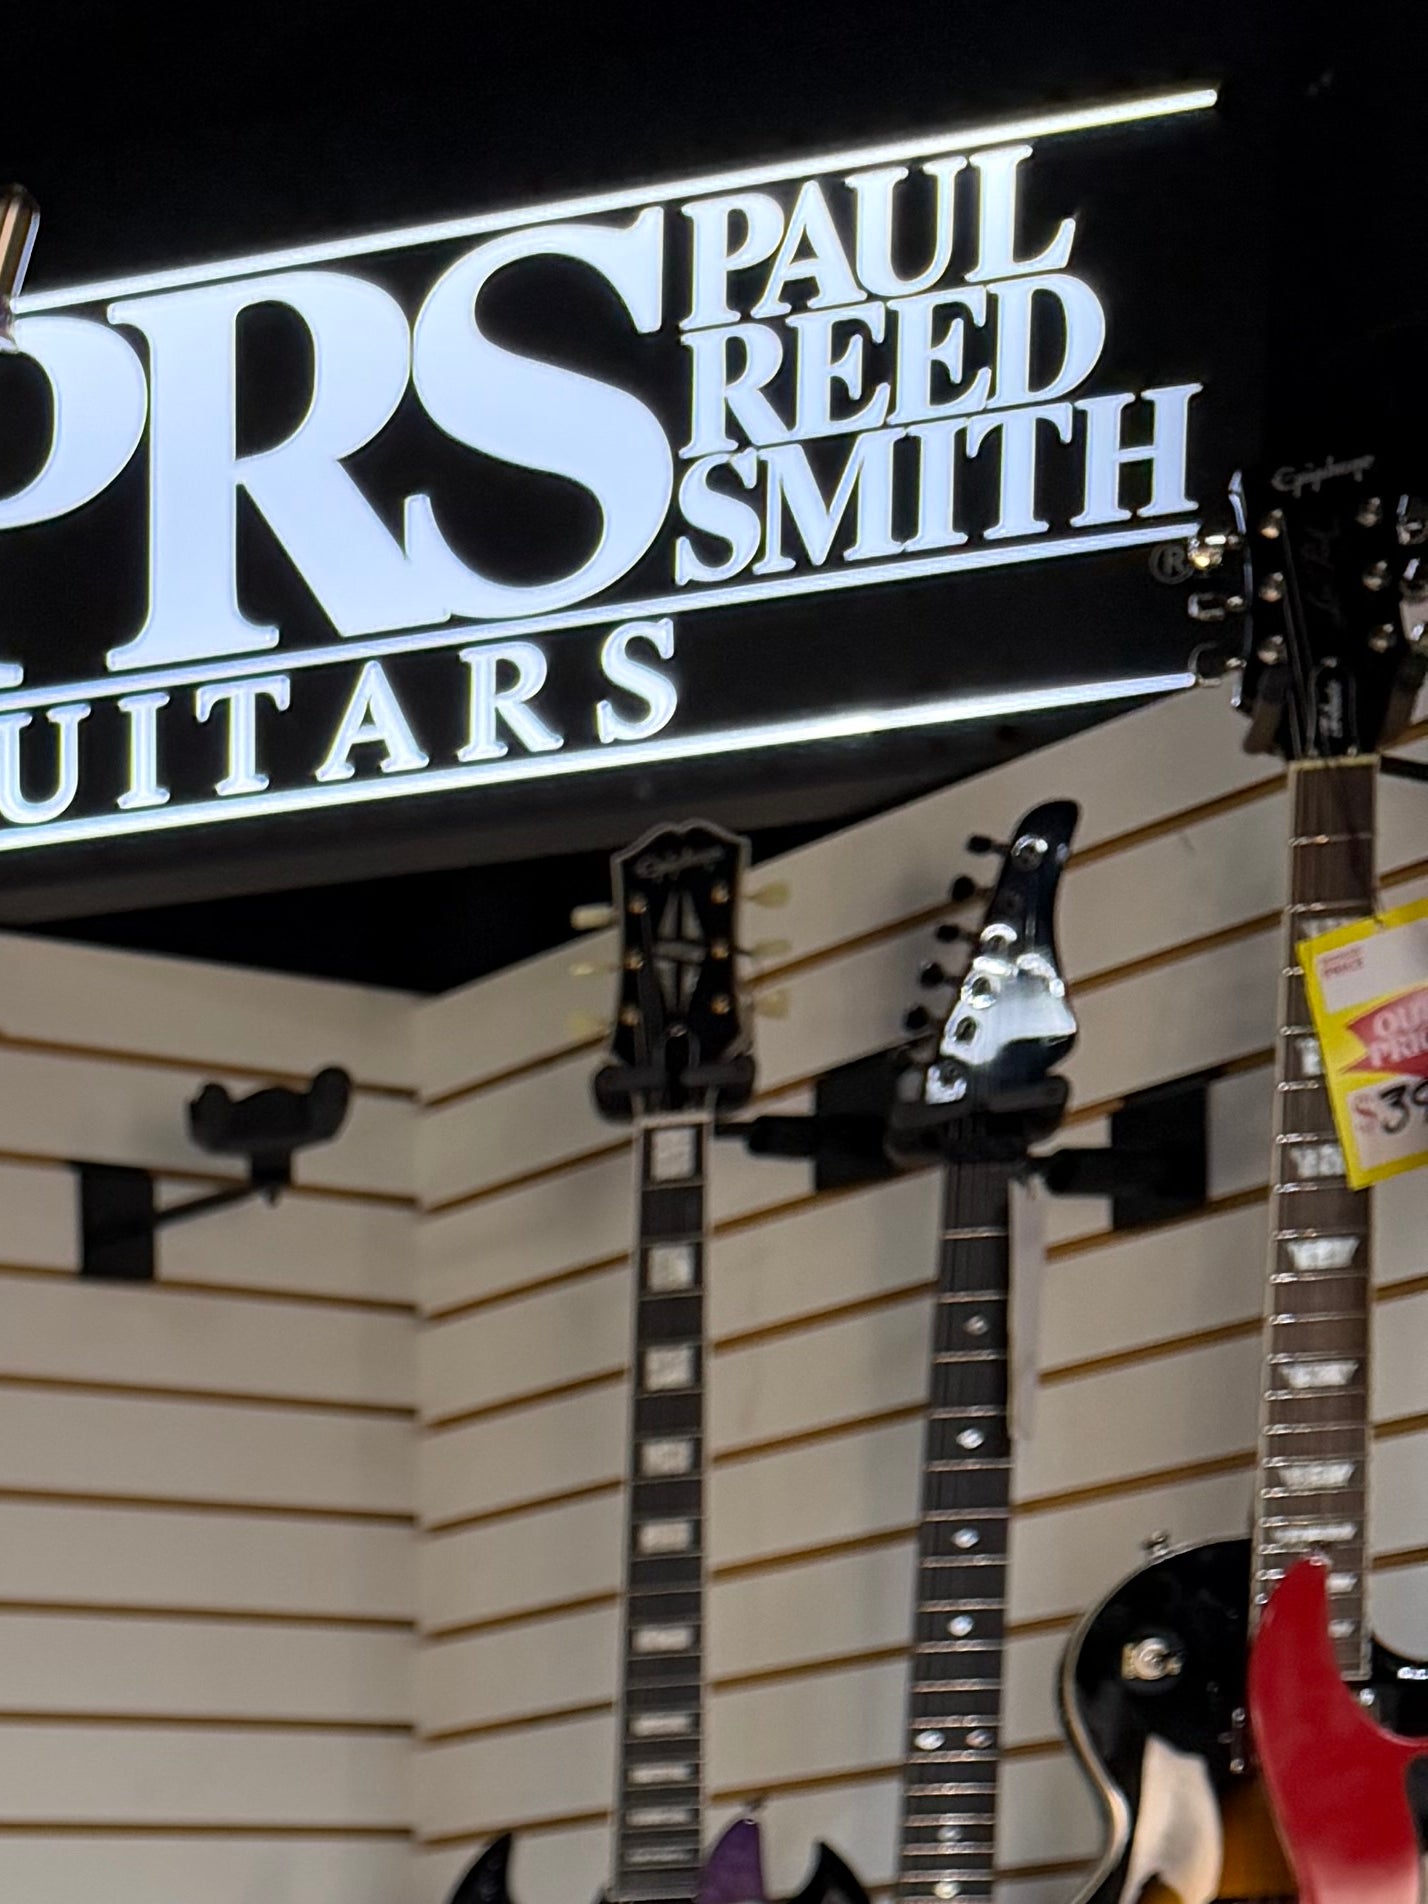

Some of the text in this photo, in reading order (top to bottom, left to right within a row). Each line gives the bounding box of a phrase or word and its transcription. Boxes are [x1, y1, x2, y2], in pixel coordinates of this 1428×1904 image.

[681, 145, 1076, 330] PAUL
[681, 271, 1107, 459] REED
[674, 382, 1204, 587] SMITH
